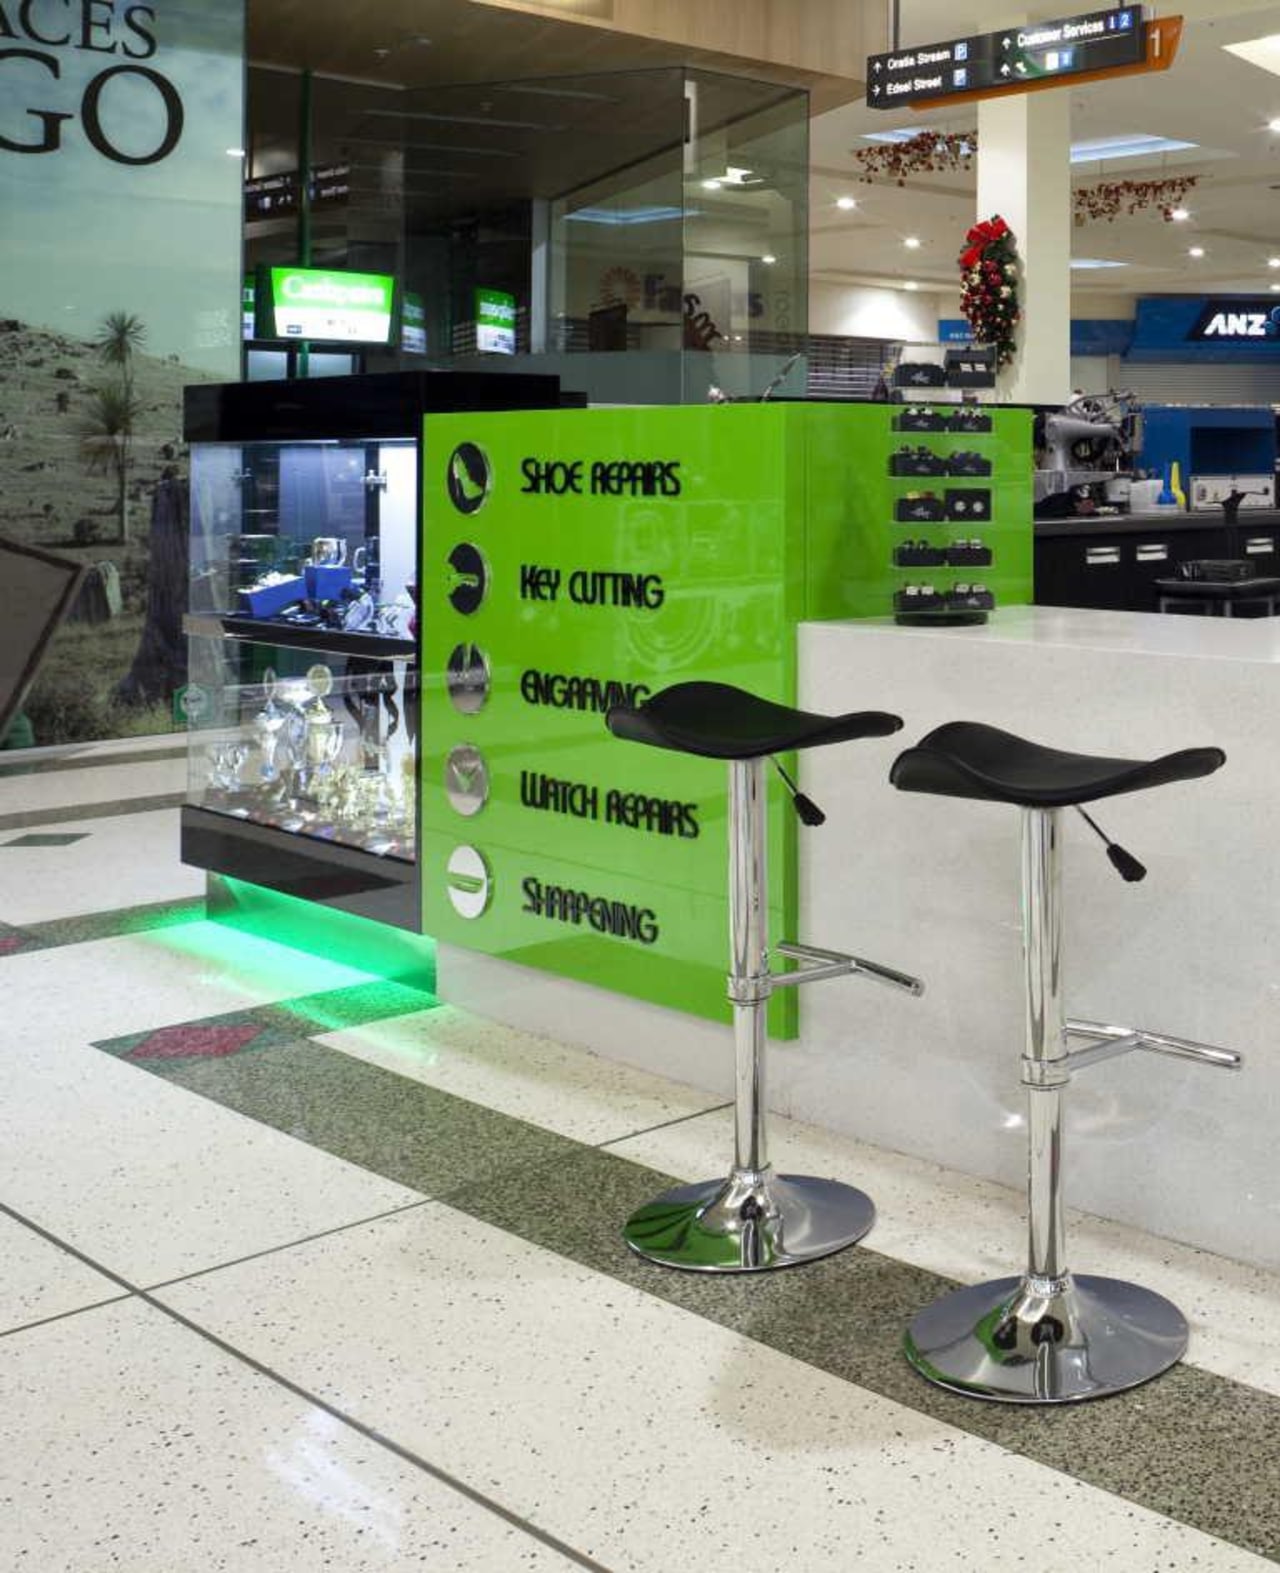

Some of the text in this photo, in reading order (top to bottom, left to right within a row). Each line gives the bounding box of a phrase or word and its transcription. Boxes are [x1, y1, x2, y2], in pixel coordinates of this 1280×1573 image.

[1063, 20, 1105, 40] Services
[1151, 28, 1161, 57] 1
[916, 50, 951, 65] Stream
[914, 76, 942, 91] Street
[0, 47, 184, 166] GO
[1204, 313, 1267, 337] ANZ
[520, 457, 682, 497] SHOE REPAIRS
[520, 564, 665, 610] KEY CUTTING
[519, 770, 700, 840] WATCH REPAIRS
[521, 876, 659, 945] SHARPENING
